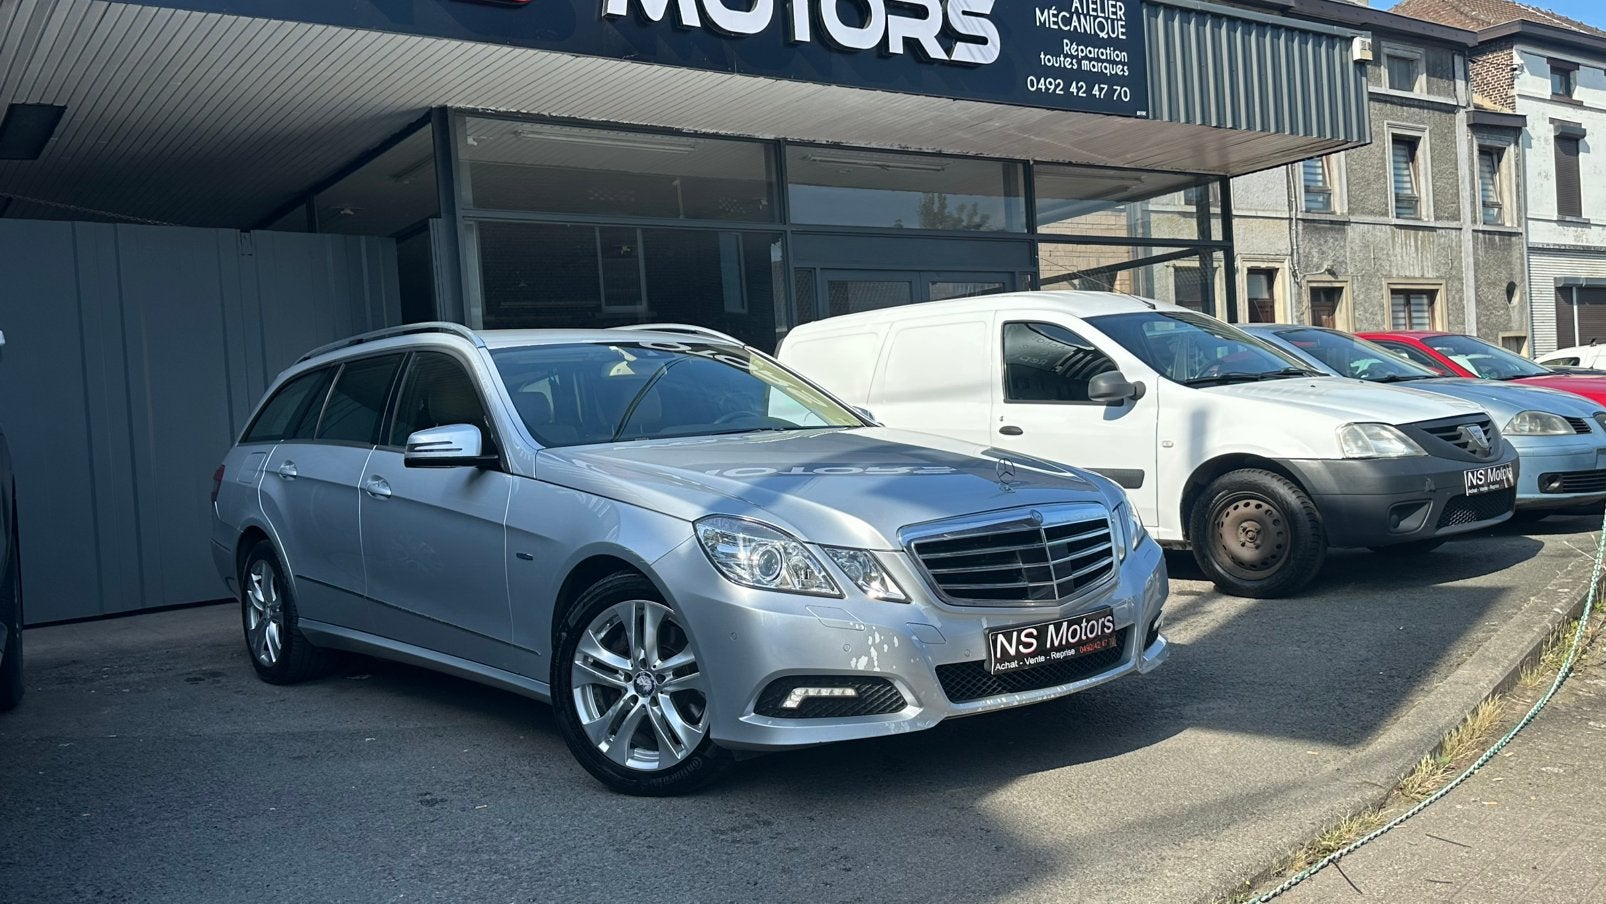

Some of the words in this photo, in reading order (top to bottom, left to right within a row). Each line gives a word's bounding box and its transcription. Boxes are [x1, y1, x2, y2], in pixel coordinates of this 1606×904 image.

[1071, 0, 1126, 20] ATELIER
[1035, 6, 1127, 39] MÉCANIQUE
[1063, 39, 1128, 62] Réparation
[1040, 51, 1078, 70] toutes
[1081, 60, 1129, 76] marques
[1027, 76, 1064, 94] 0492
[1069, 81, 1087, 97] 42
[1092, 83, 1108, 99] 47
[1113, 86, 1130, 101] 70
[1467, 469, 1485, 487] NS
[996, 627, 1038, 659] NS
[1046, 615, 1114, 649] Motors
[995, 660, 1018, 671] Achat
[1024, 655, 1045, 665] Vente
[1051, 648, 1076, 660] Reprise
